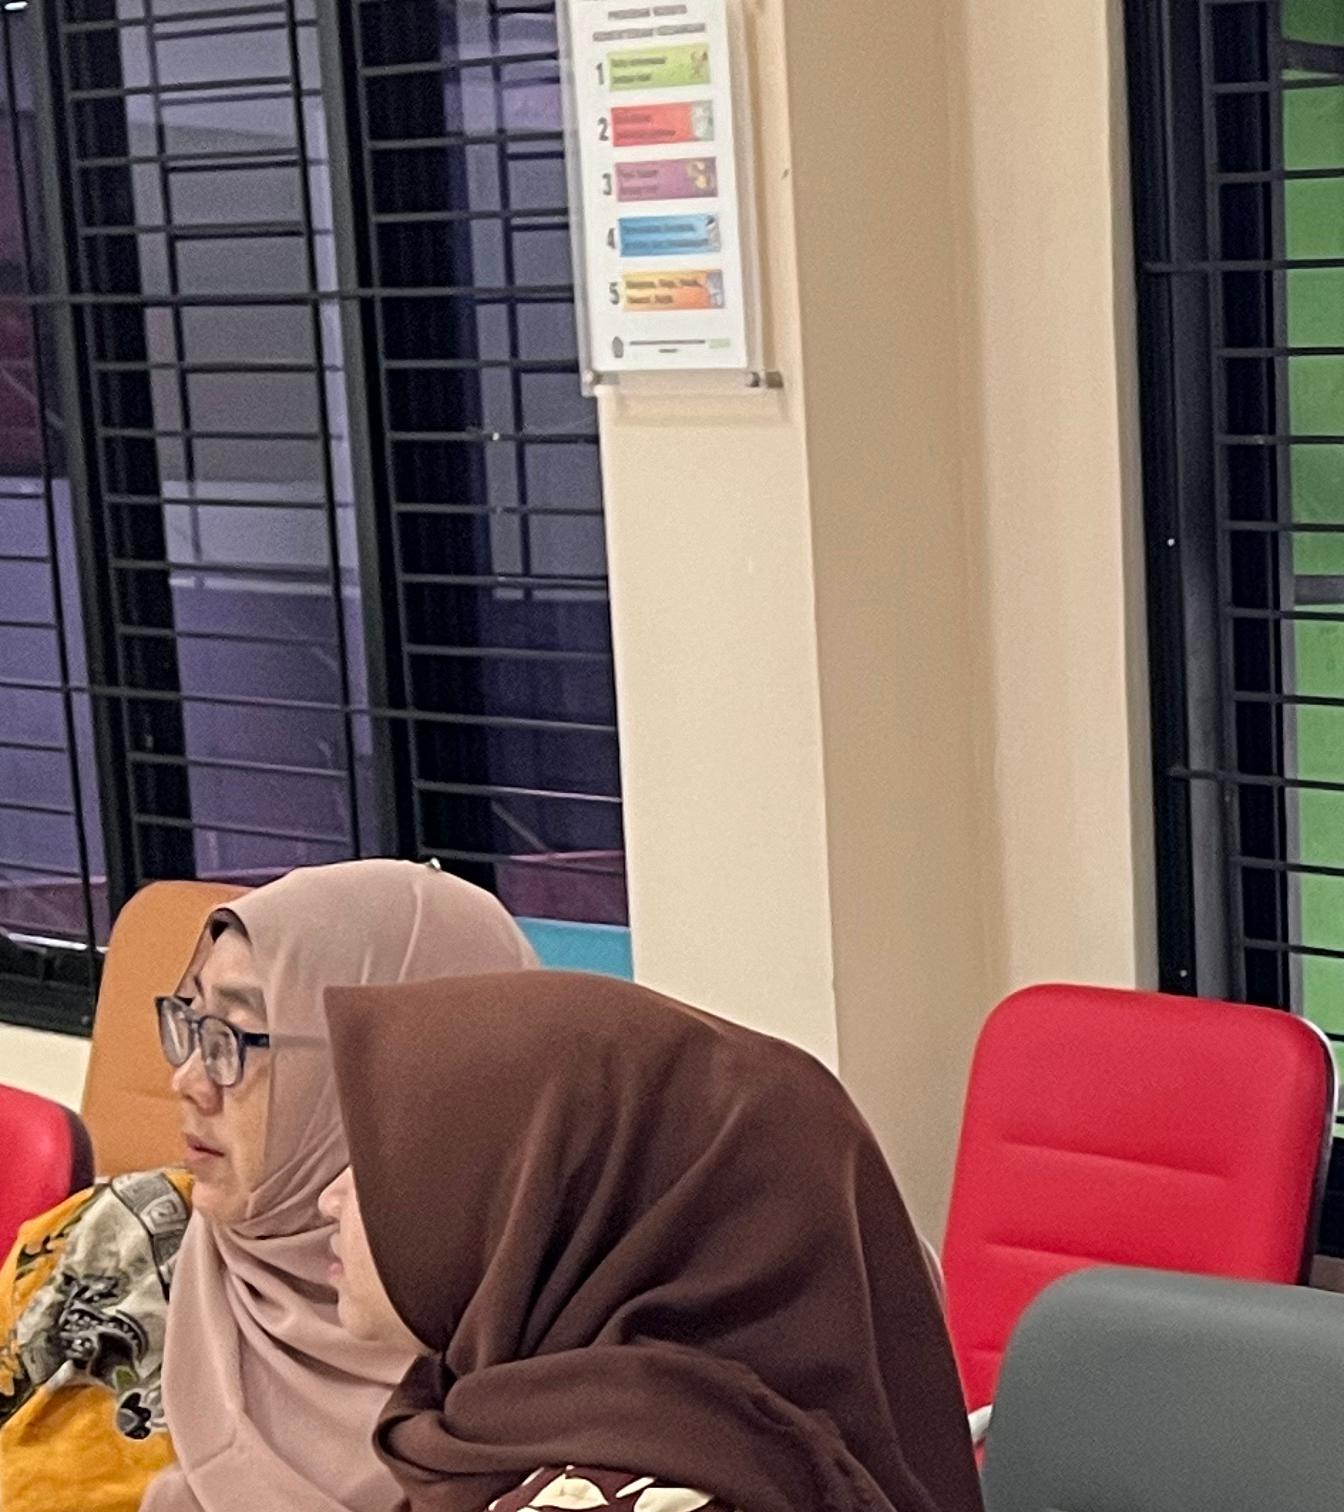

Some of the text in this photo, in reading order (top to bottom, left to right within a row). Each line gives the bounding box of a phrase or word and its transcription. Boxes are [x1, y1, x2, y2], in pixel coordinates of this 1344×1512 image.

[595, 62, 605, 85] 1
[597, 117, 609, 141] 2
[602, 173, 612, 196] 3
[609, 281, 620, 305] 5
